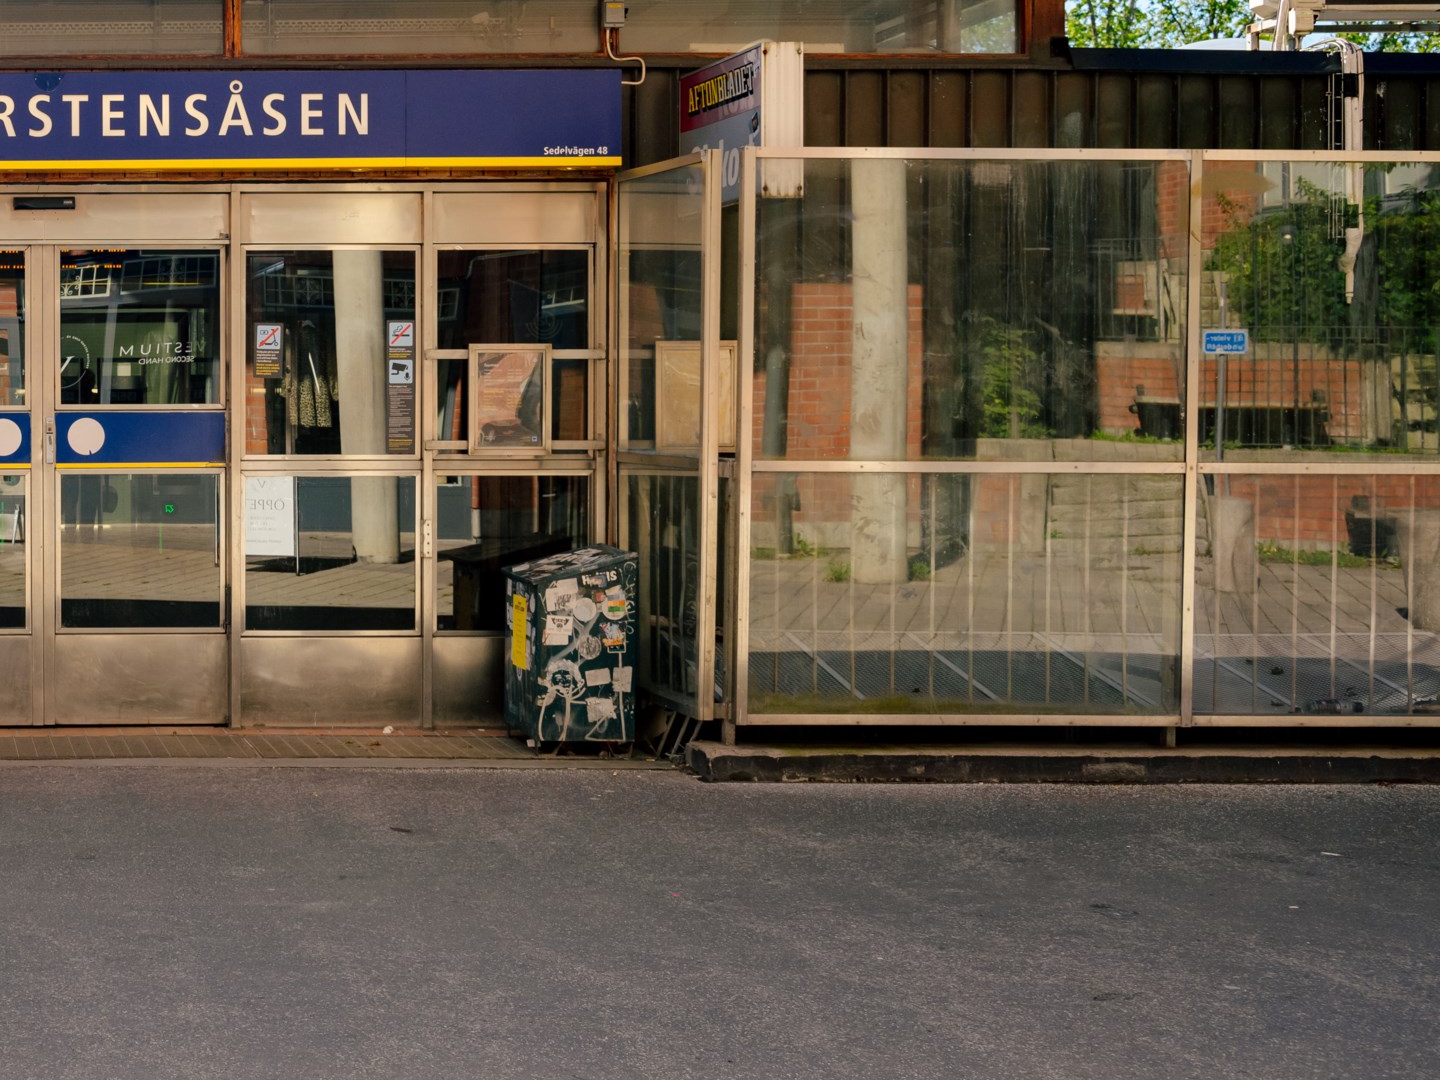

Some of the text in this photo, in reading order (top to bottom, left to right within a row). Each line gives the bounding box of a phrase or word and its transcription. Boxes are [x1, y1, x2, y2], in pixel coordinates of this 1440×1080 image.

[687, 63, 754, 114] AFTONBLADET
[543, 145, 609, 157] Sedelvägen 48
